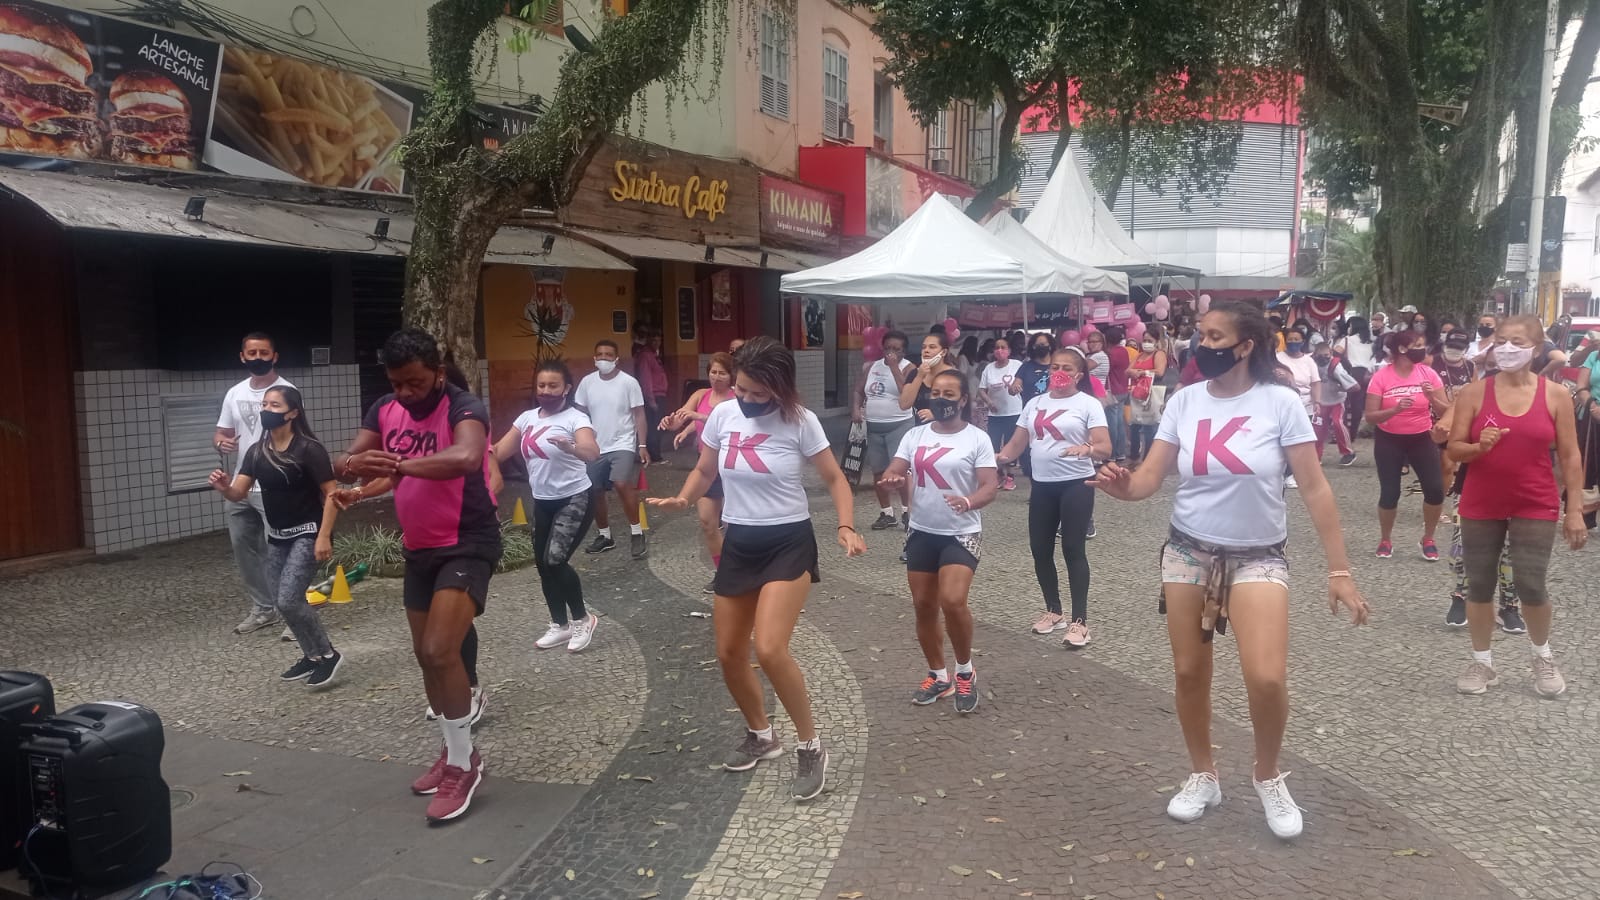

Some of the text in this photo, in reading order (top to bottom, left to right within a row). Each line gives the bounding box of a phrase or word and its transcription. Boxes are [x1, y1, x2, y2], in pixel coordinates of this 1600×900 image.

[138, 45, 211, 91] ARTESANAL
[152, 33, 205, 71] LANCHE
[609, 160, 728, 222] Sintra Café
[770, 189, 833, 228] KIMANIA
[385, 428, 437, 457] COXA
[522, 425, 552, 460] K
[1034, 409, 1068, 441] K
[724, 432, 773, 474] K
[1192, 416, 1256, 476] K
[914, 446, 954, 490] K
